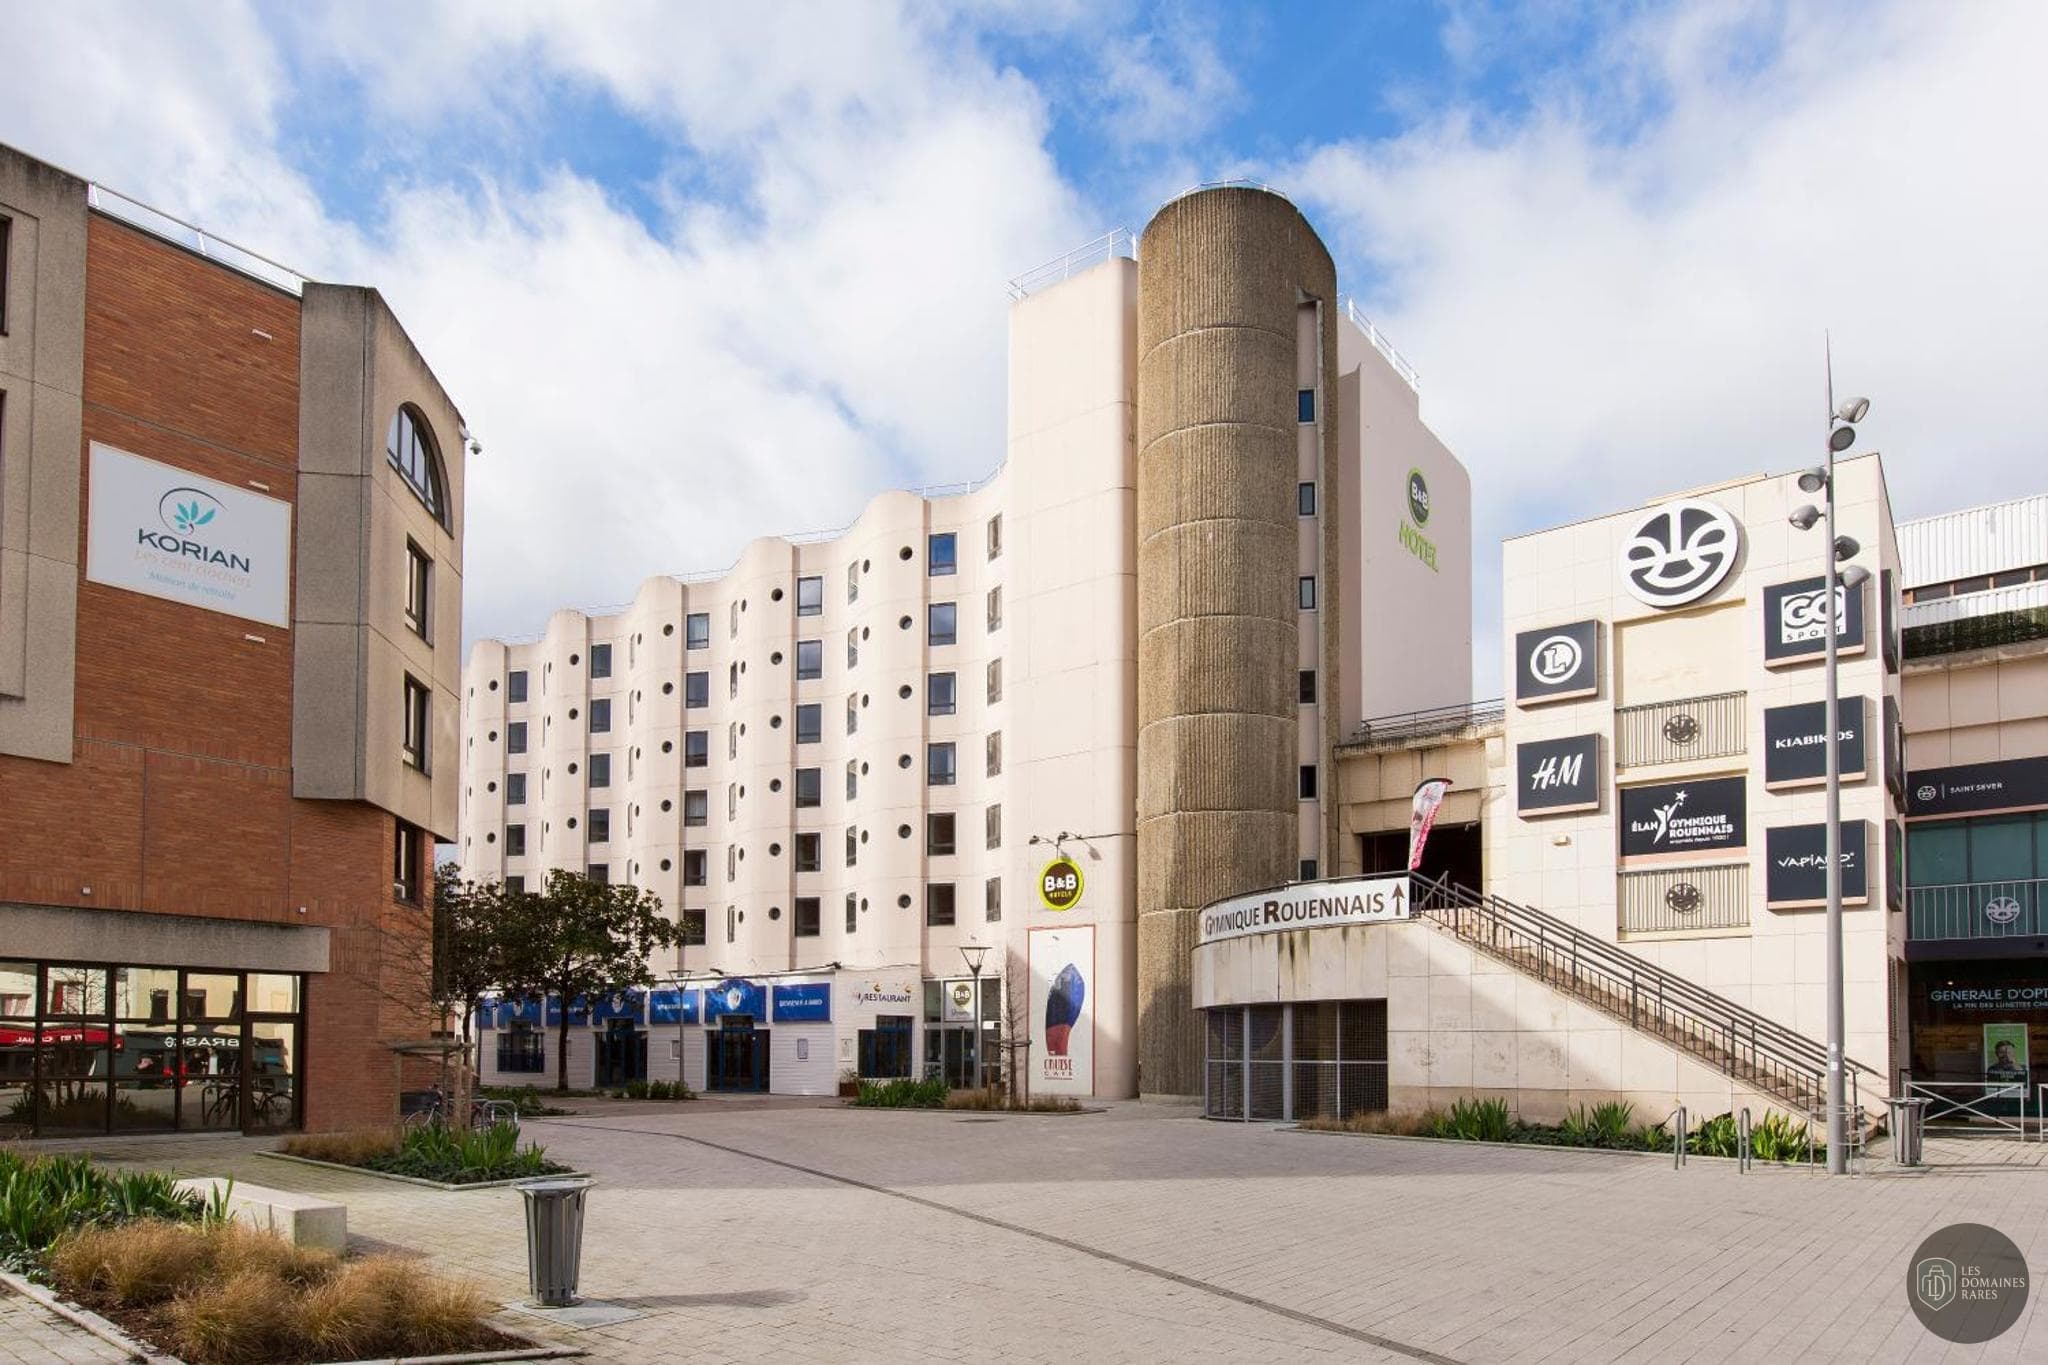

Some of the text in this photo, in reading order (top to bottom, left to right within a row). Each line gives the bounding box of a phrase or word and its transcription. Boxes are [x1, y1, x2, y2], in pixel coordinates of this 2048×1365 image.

[138, 528, 250, 573] KORIAN
[1399, 520, 1438, 573] HOTEL
[1784, 589, 1843, 629] GO
[1786, 625, 1842, 641] SPOT
[1775, 730, 1855, 749] KIABIKDS
[1531, 753, 1583, 790] H&M
[1950, 782, 2003, 794] SAINT SEVER
[1631, 820, 1658, 832] ÉLAN
[1668, 814, 1727, 829] GYMNIQUE
[1669, 823, 1734, 839] ROUENNAIS
[1045, 874, 1077, 892] B&B
[1263, 892, 1385, 925] ROUENNAIS
[864, 993, 911, 1003] RESTAURANT
